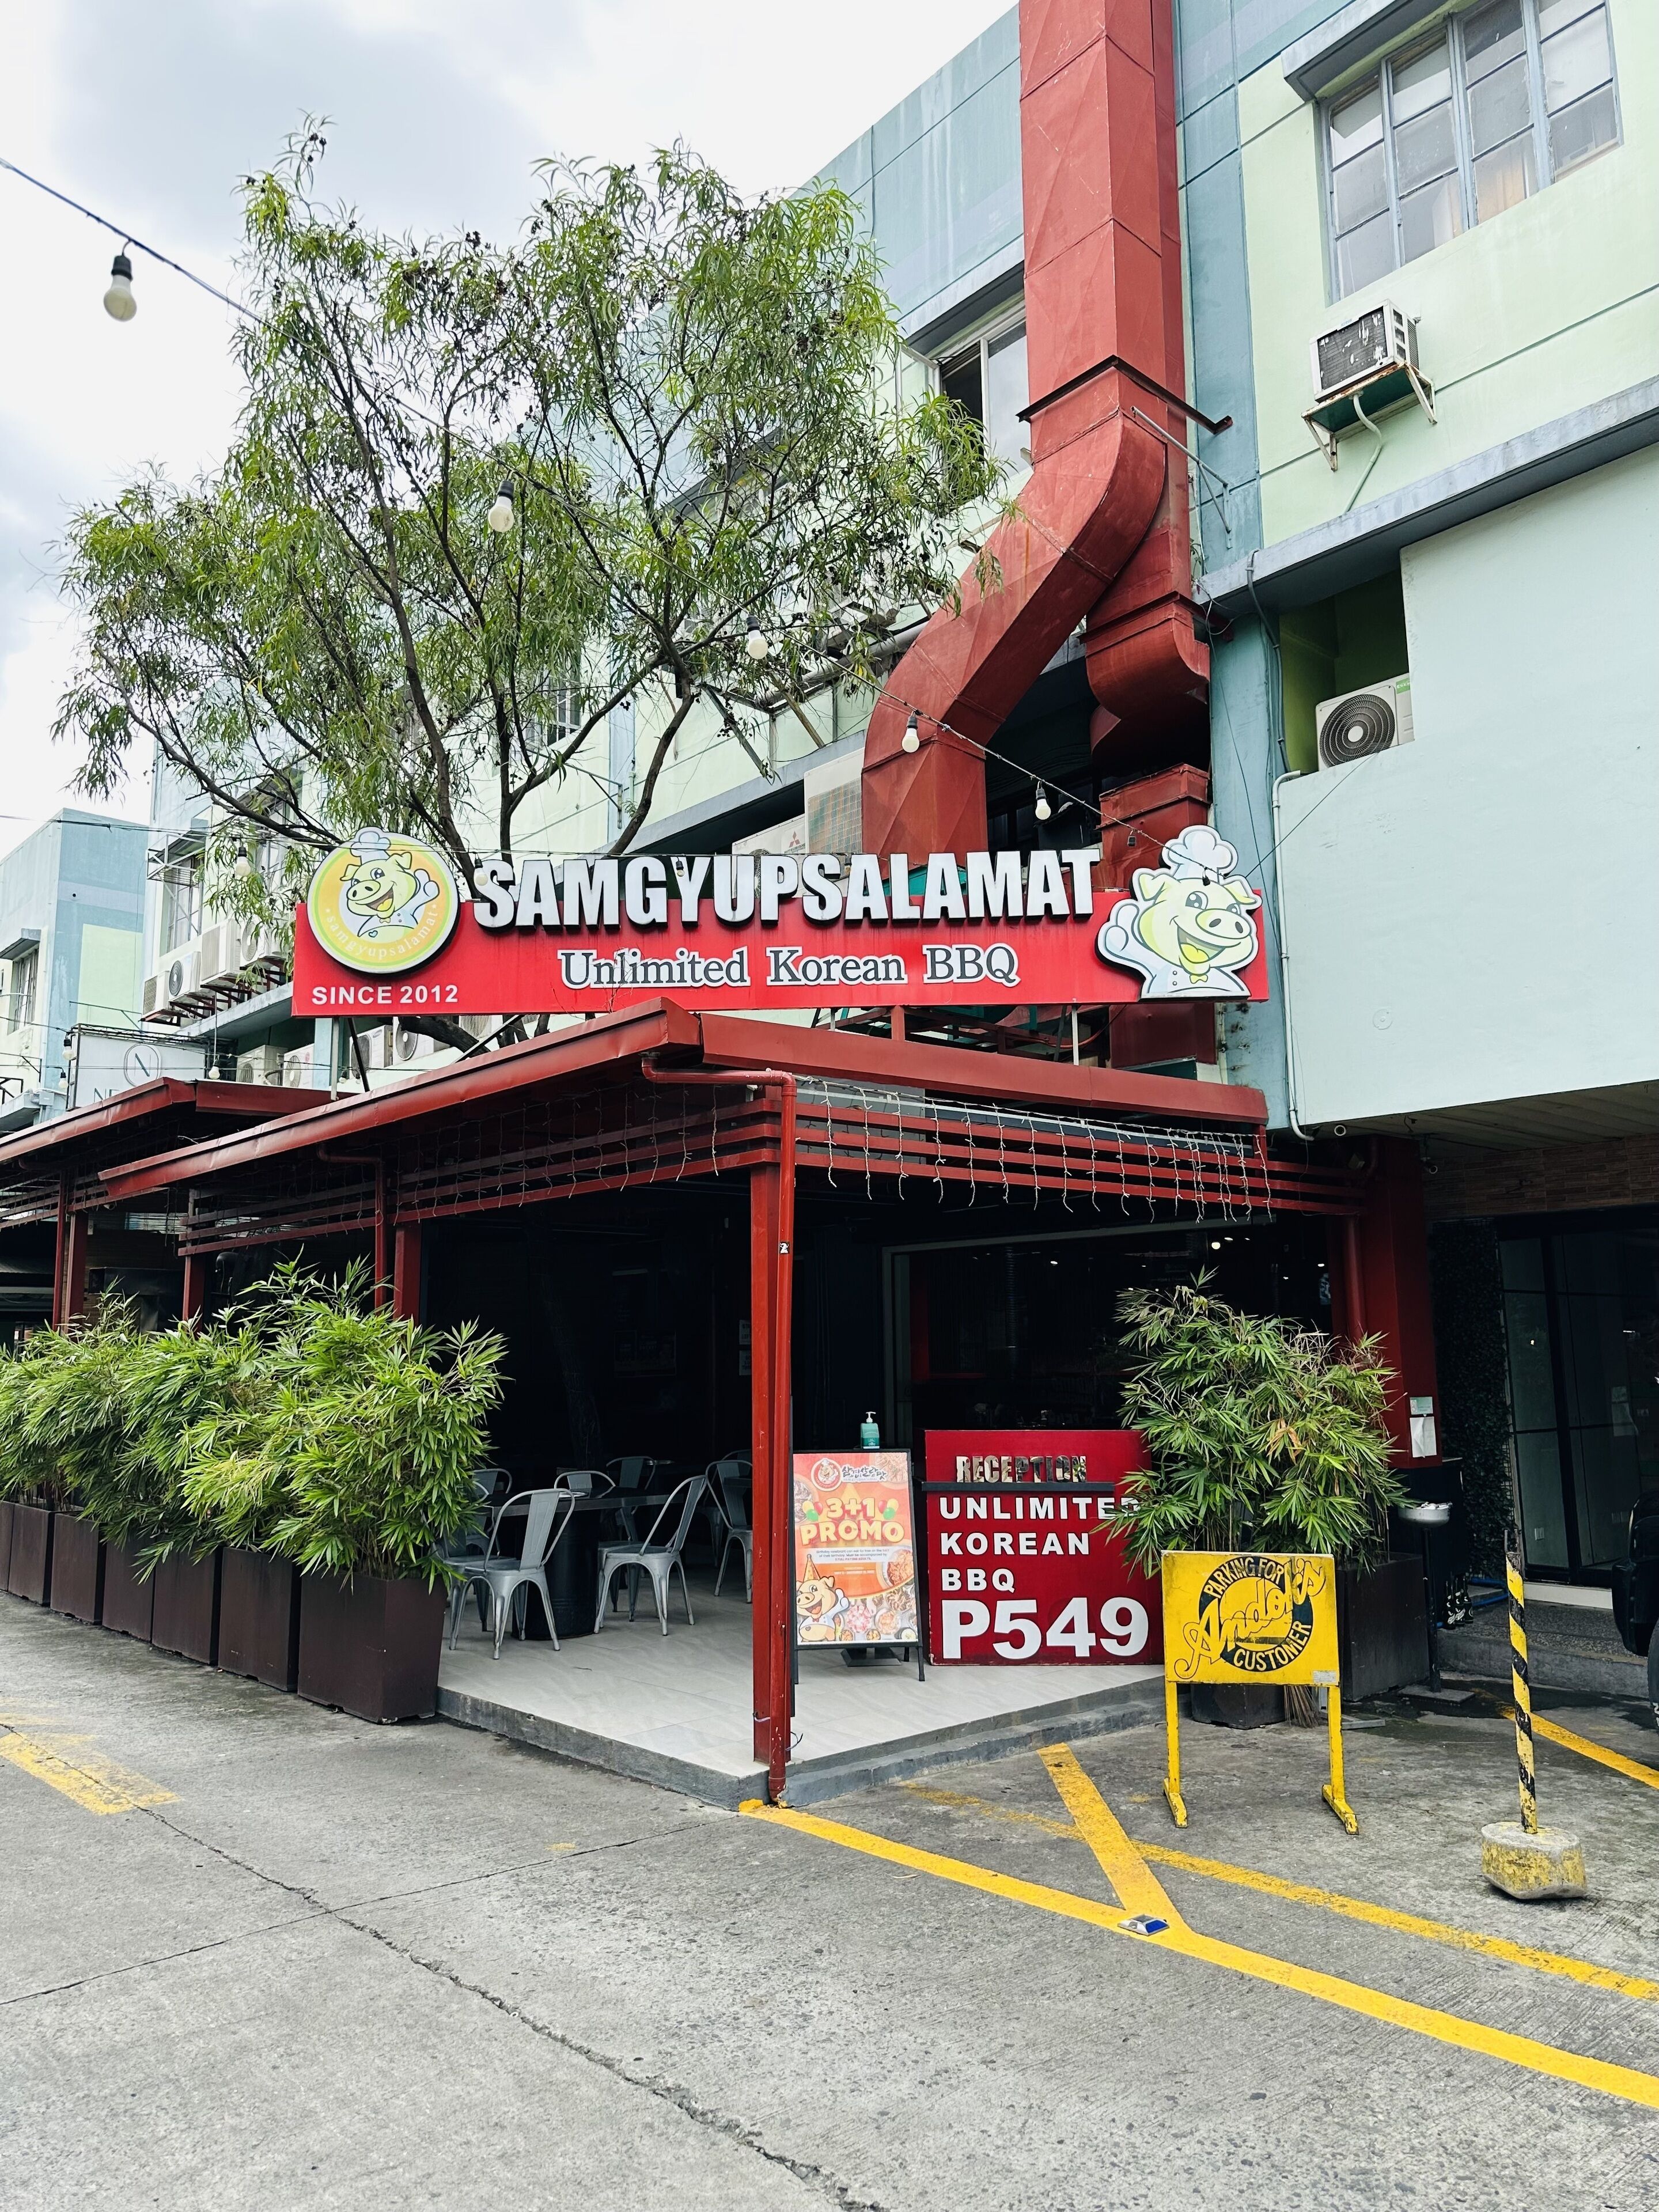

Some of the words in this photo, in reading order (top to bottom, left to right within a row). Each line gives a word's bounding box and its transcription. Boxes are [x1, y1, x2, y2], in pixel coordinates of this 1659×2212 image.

[474, 849, 1101, 929] SAMGYUPSALAMAT
[326, 911, 438, 960] samgyupsalamat
[559, 948, 749, 987] Unlimited
[768, 948, 906, 984] Korean
[924, 945, 1020, 986] BBQ
[312, 986, 392, 1005] SINCE
[400, 984, 459, 1003] 2012
[956, 1456, 1087, 1483] RECEPTION
[825, 1497, 876, 1518] 3+1
[800, 1520, 905, 1546] PROMO
[941, 1532, 1090, 1555] KOREAN
[941, 1569, 1016, 1593] BBQ
[1204, 1557, 1255, 1599] PARKING
[1258, 1558, 1285, 1584] FOR
[941, 1597, 1150, 1660] P549
[1233, 1620, 1312, 1671] CUSTOMER
